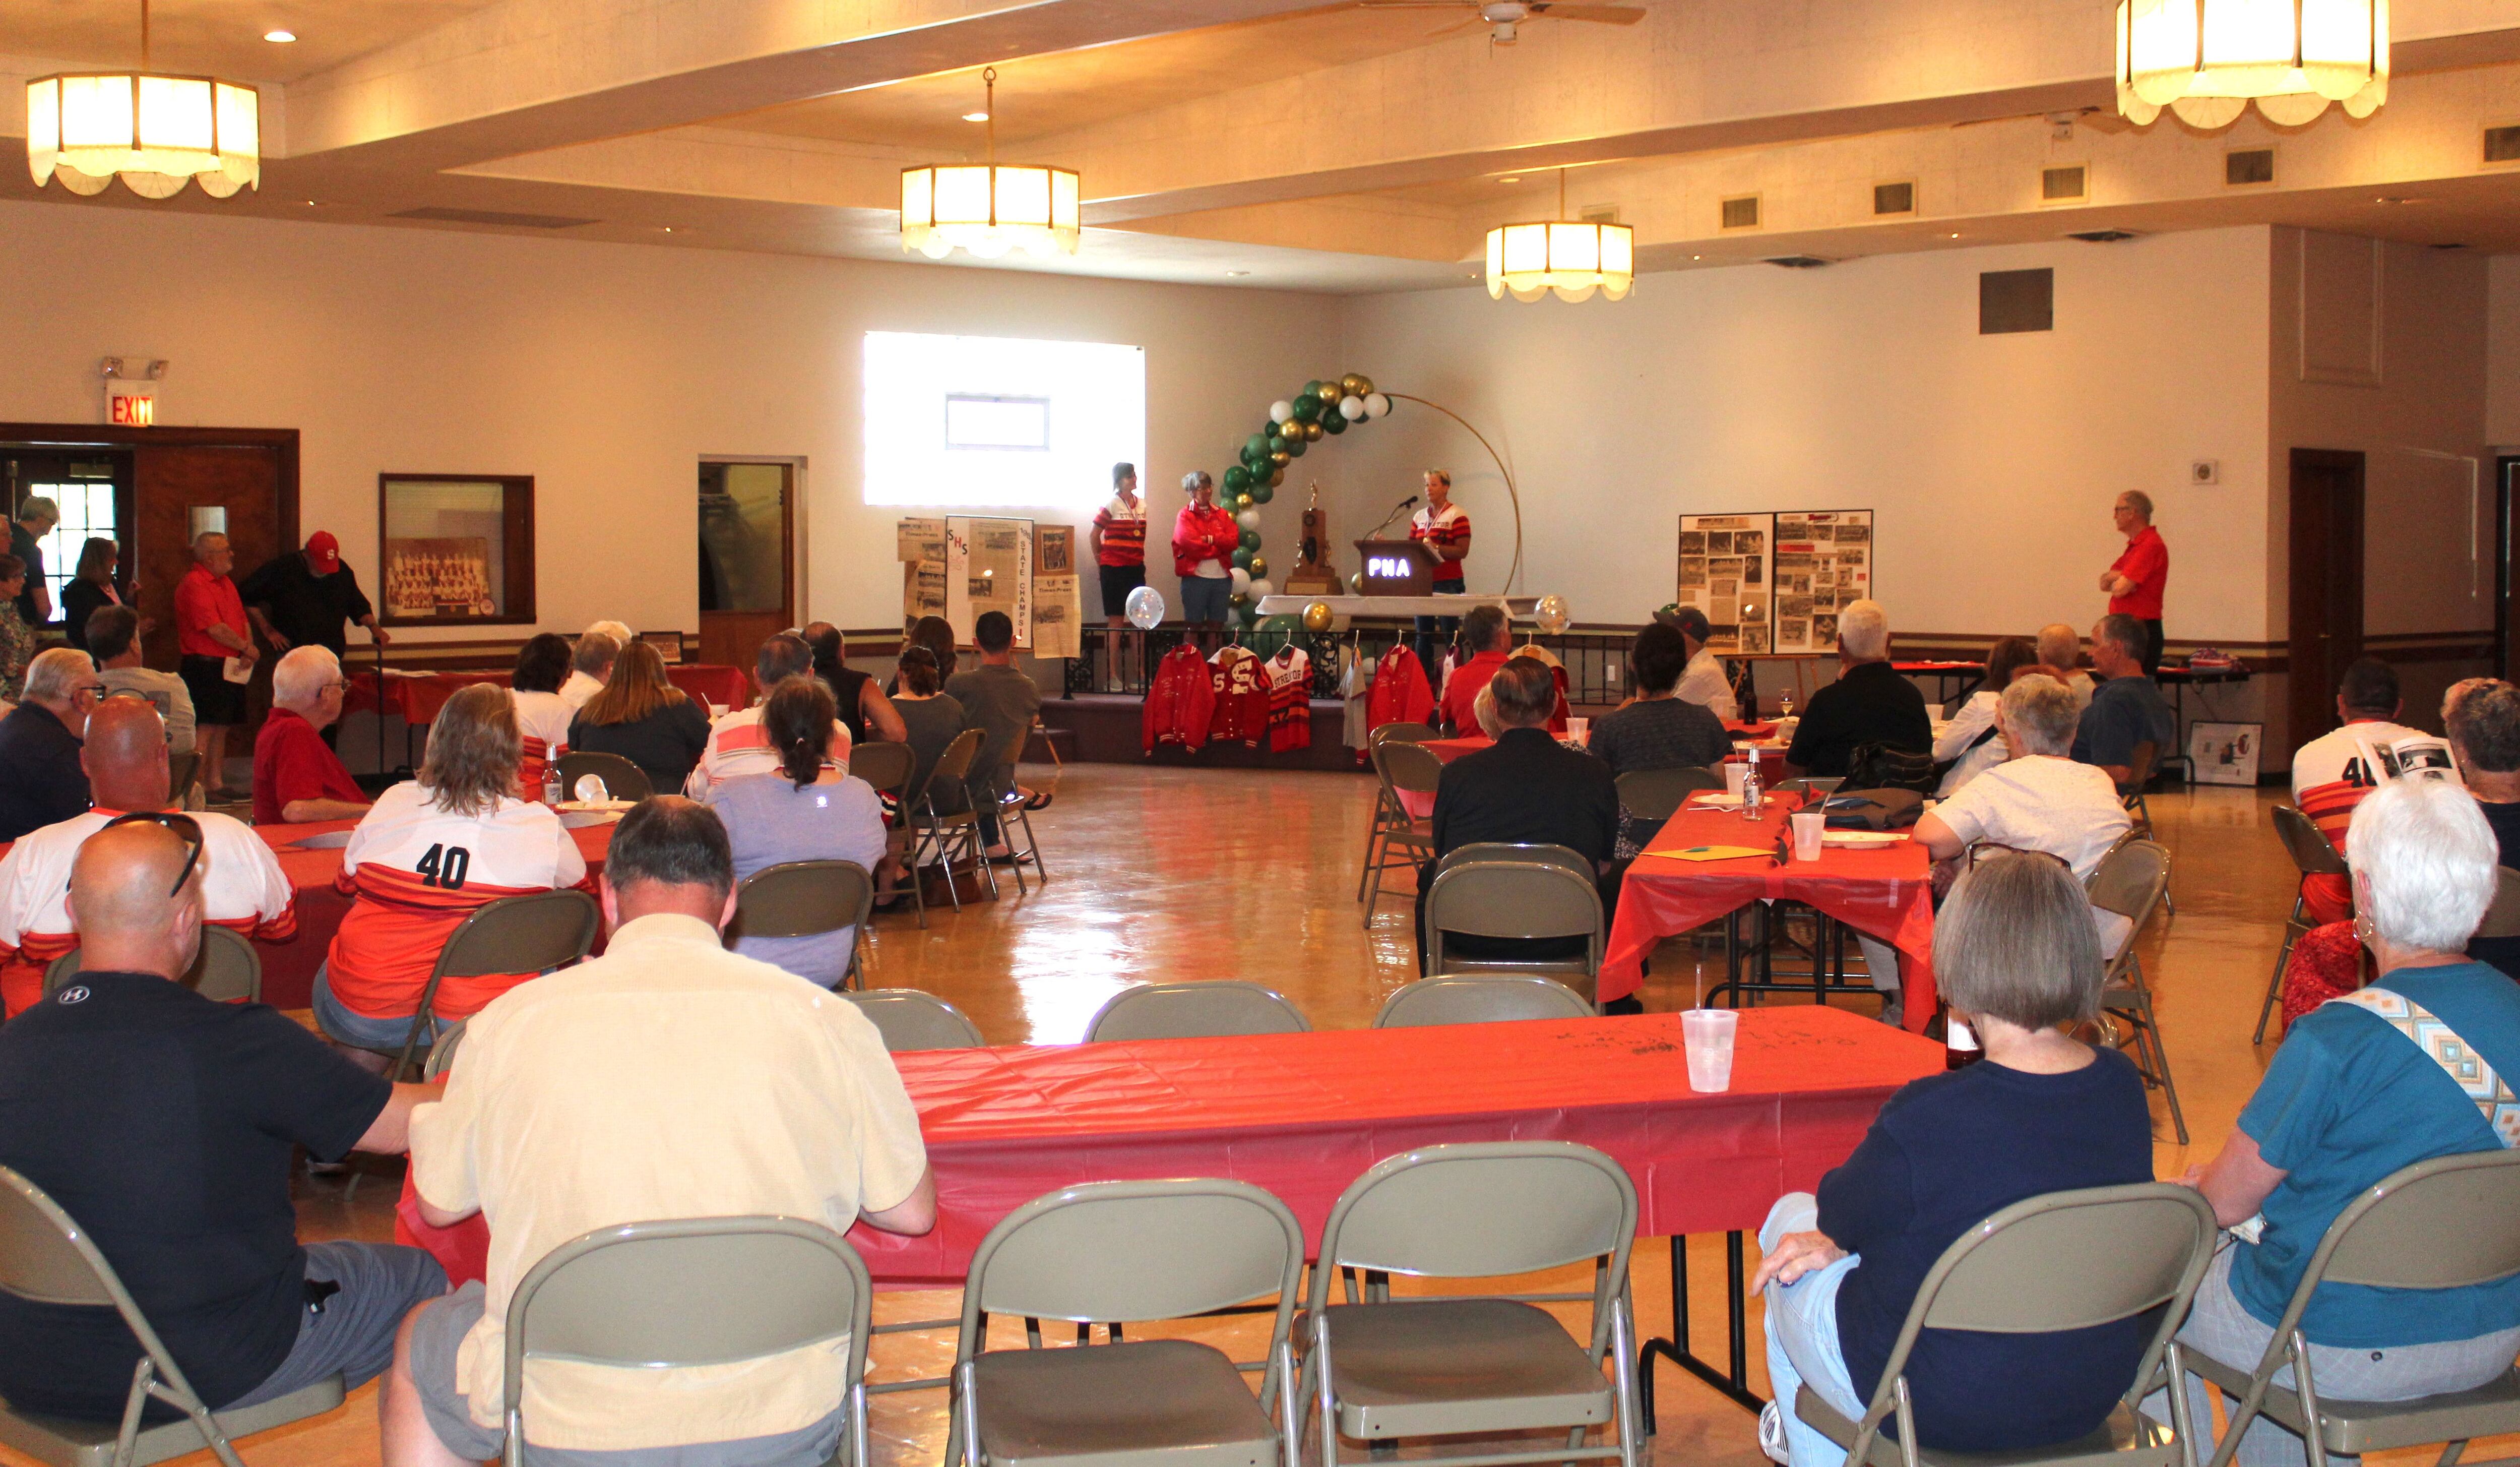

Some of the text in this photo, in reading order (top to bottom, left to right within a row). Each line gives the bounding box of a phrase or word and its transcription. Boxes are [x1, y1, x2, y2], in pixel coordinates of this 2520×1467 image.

[113, 396, 150, 423] EXIT
[1368, 558, 1410, 577] PNA
[1213, 673, 1225, 694] S
[1274, 670, 1301, 688] STREOR
[416, 843, 470, 890] 40
